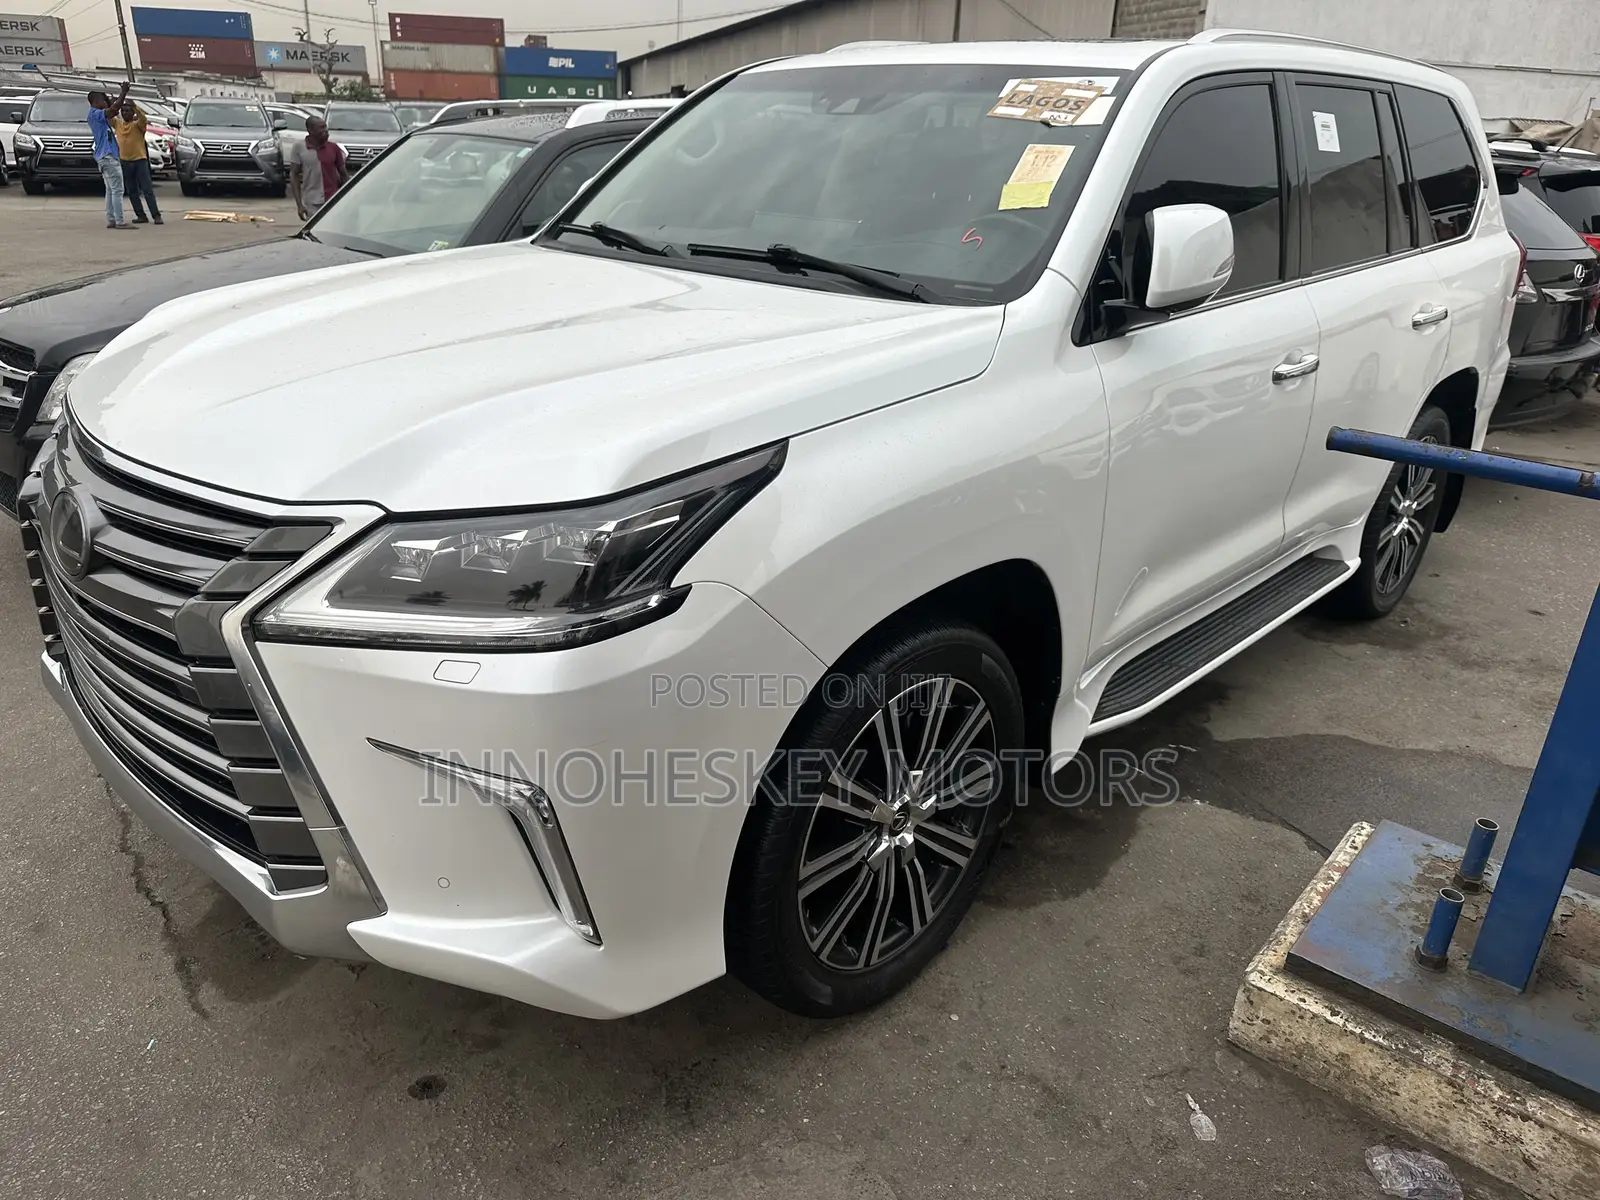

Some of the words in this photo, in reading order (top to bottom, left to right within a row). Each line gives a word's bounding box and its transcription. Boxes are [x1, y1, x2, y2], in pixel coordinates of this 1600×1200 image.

[189, 50, 206, 59] ZIM
[558, 57, 575, 69] PIL
[1005, 92, 1087, 111] LAGOS
